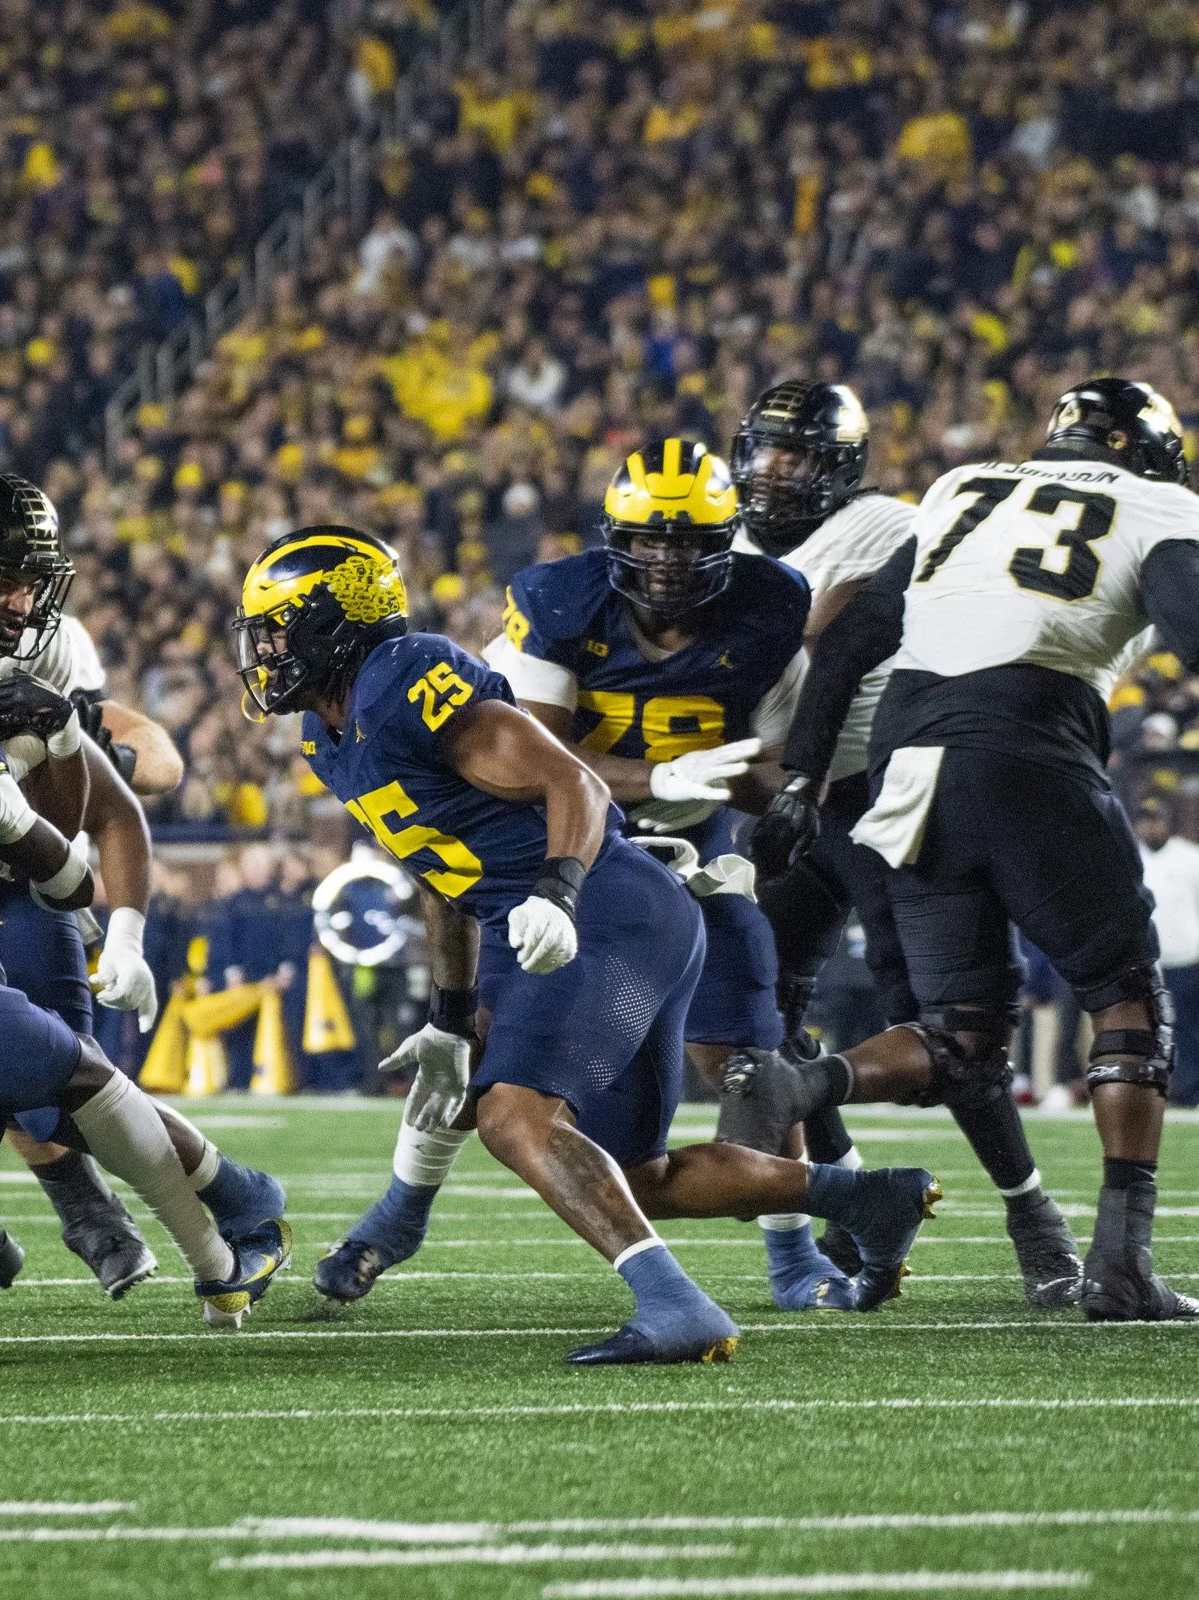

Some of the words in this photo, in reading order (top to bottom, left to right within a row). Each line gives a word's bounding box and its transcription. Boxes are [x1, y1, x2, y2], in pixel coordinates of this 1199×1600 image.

[914, 477, 1117, 602] 73
[407, 662, 474, 733] 25
[576, 690, 726, 762] 78
